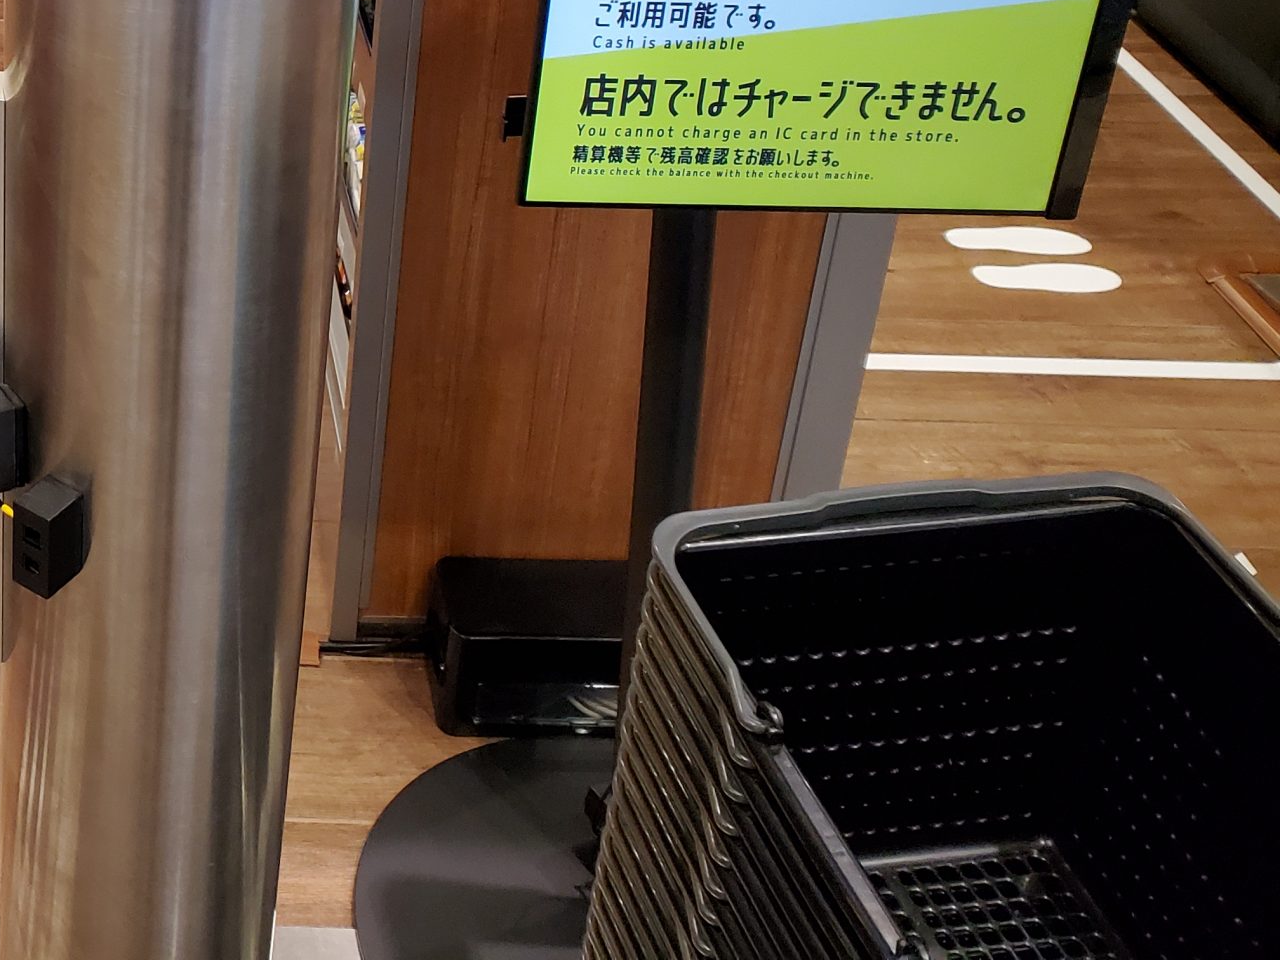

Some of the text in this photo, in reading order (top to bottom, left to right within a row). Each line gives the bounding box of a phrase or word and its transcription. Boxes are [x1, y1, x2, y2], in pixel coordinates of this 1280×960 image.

[595, 0, 776, 30] ご利用可能です。
[593, 35, 745, 51] Cash is available
[579, 73, 1026, 123] 店内ではチャージできません。
[577, 124, 959, 142] You cannot charge an IC card in the store.
[572, 144, 840, 167] 精算機等で残高確認をお願いします。
[570, 166, 874, 181] Please check the balance with the checkout machine.
